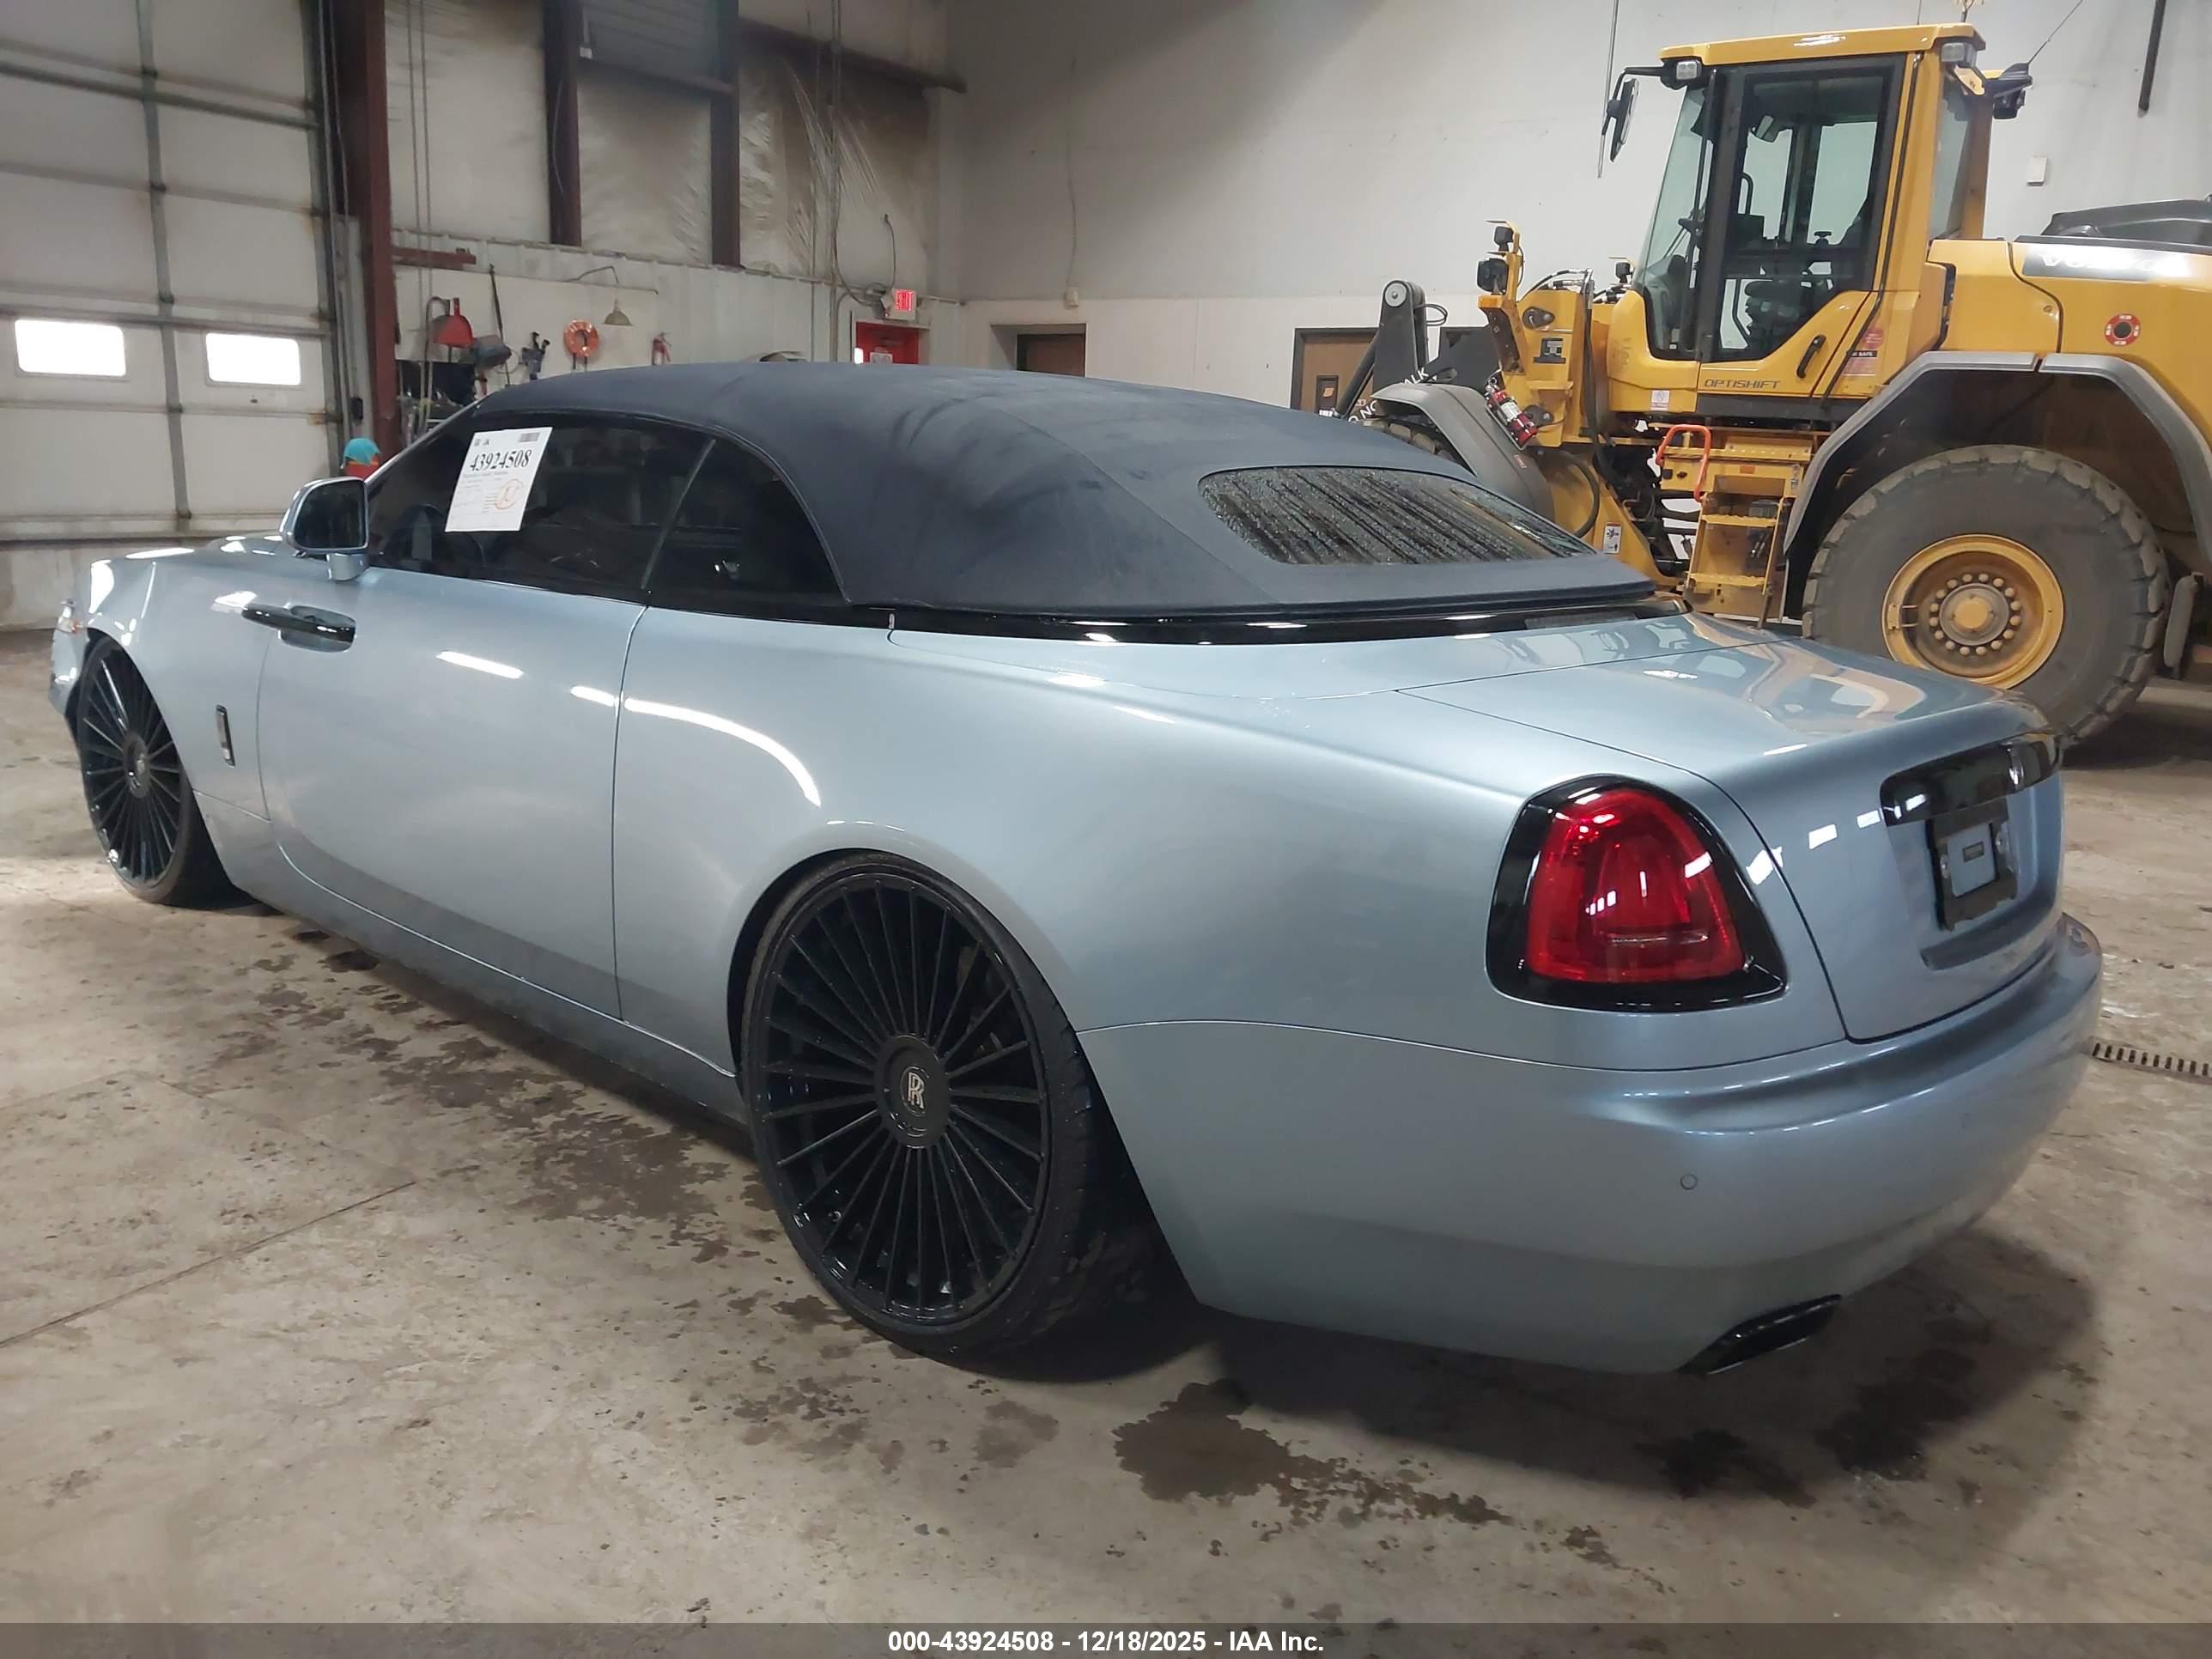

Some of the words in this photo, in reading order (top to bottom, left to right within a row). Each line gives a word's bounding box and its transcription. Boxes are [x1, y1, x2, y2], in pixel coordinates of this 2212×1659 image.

[1404, 368, 1429, 385] ALK
[1704, 379, 1781, 389] OPTISHIFT
[470, 449, 532, 471] 43924508
